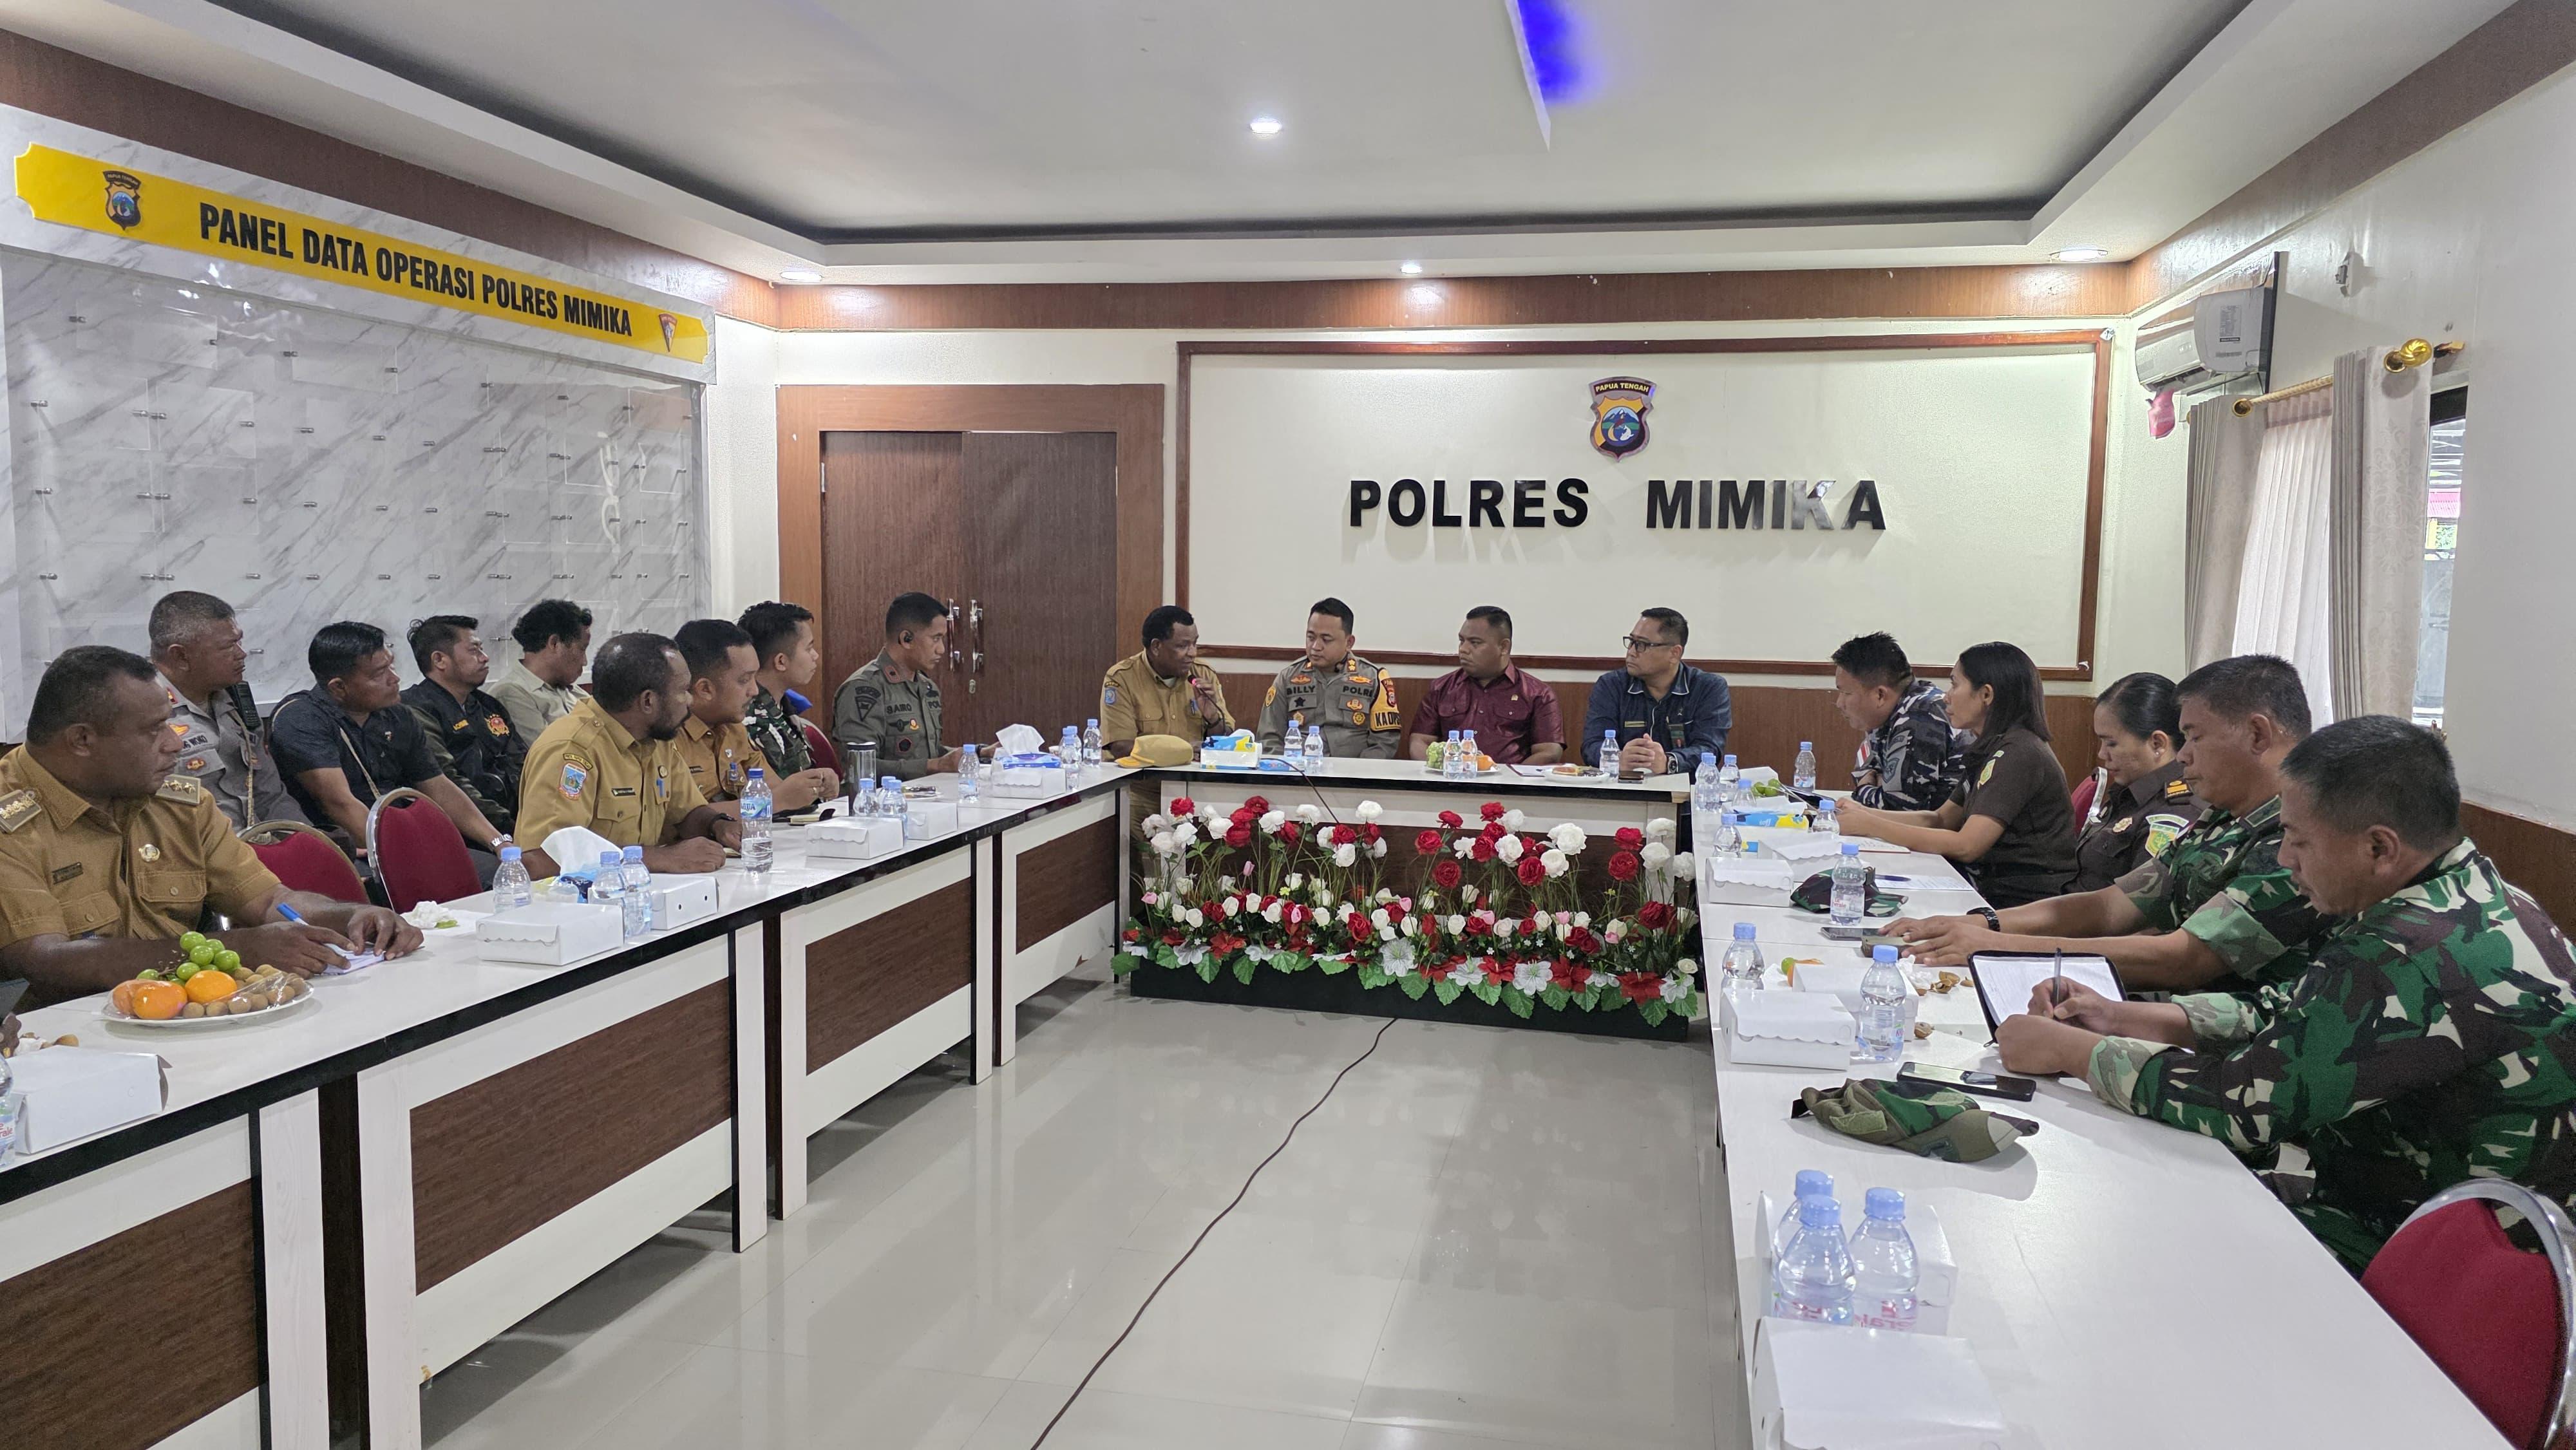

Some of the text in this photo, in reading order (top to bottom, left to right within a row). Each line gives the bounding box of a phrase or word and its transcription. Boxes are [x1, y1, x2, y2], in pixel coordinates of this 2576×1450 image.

[200, 202, 632, 337] PANEL DATA OPERASI POLRES MIMIKA
[1595, 382, 1649, 392] PAPUA TENGAH
[1350, 478, 1886, 530] POLRES MIMIKA
[1287, 685, 1316, 695] BILLY
